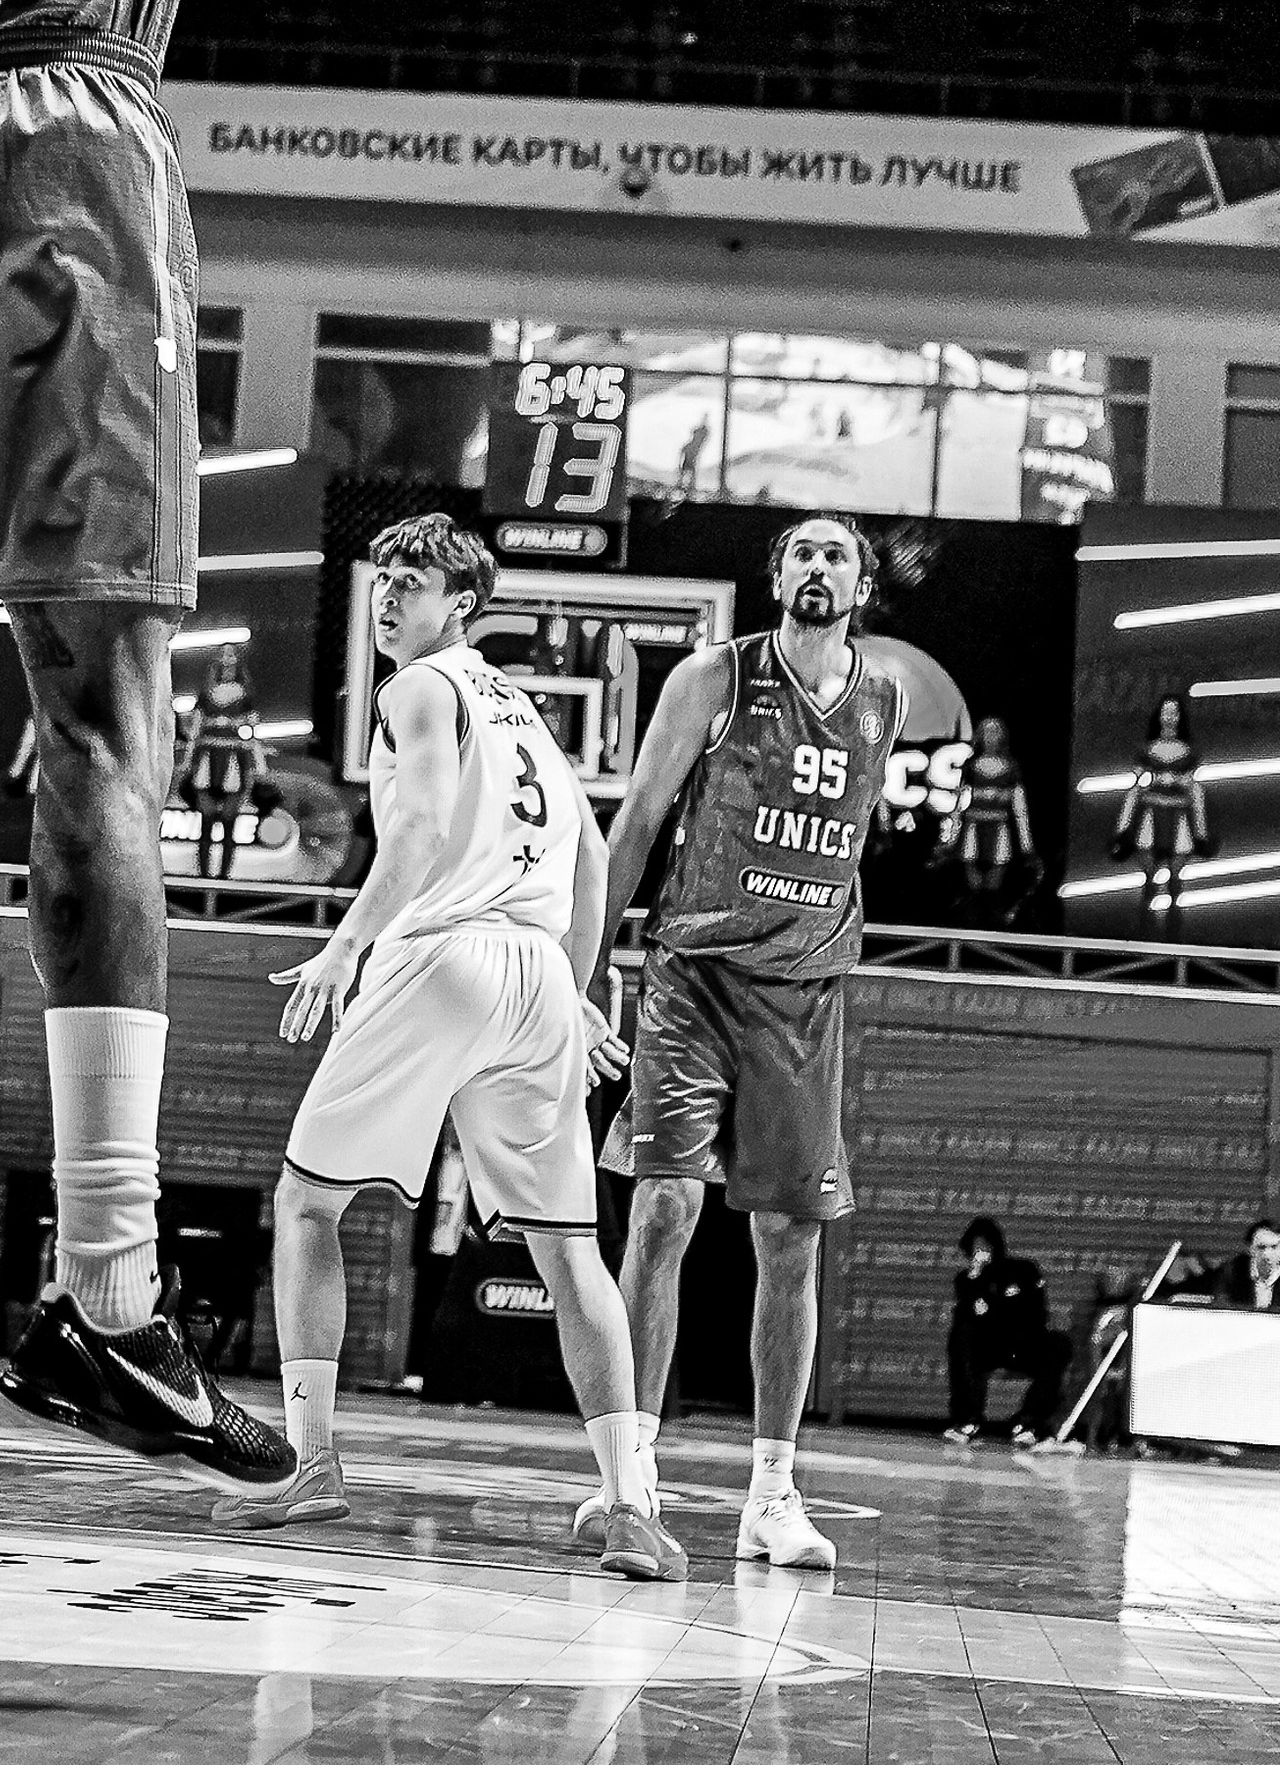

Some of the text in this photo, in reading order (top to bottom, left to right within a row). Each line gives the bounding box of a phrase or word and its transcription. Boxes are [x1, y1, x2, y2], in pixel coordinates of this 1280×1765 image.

[208, 120, 462, 167] БАНКОВСКИЕ
[760, 149, 872, 187] ЖИТЬ
[525, 421, 623, 513] 13
[510, 743, 548, 827] 3
[791, 744, 849, 801] 95
[753, 804, 858, 861] UNICS
[745, 871, 834, 908] WINLINE
